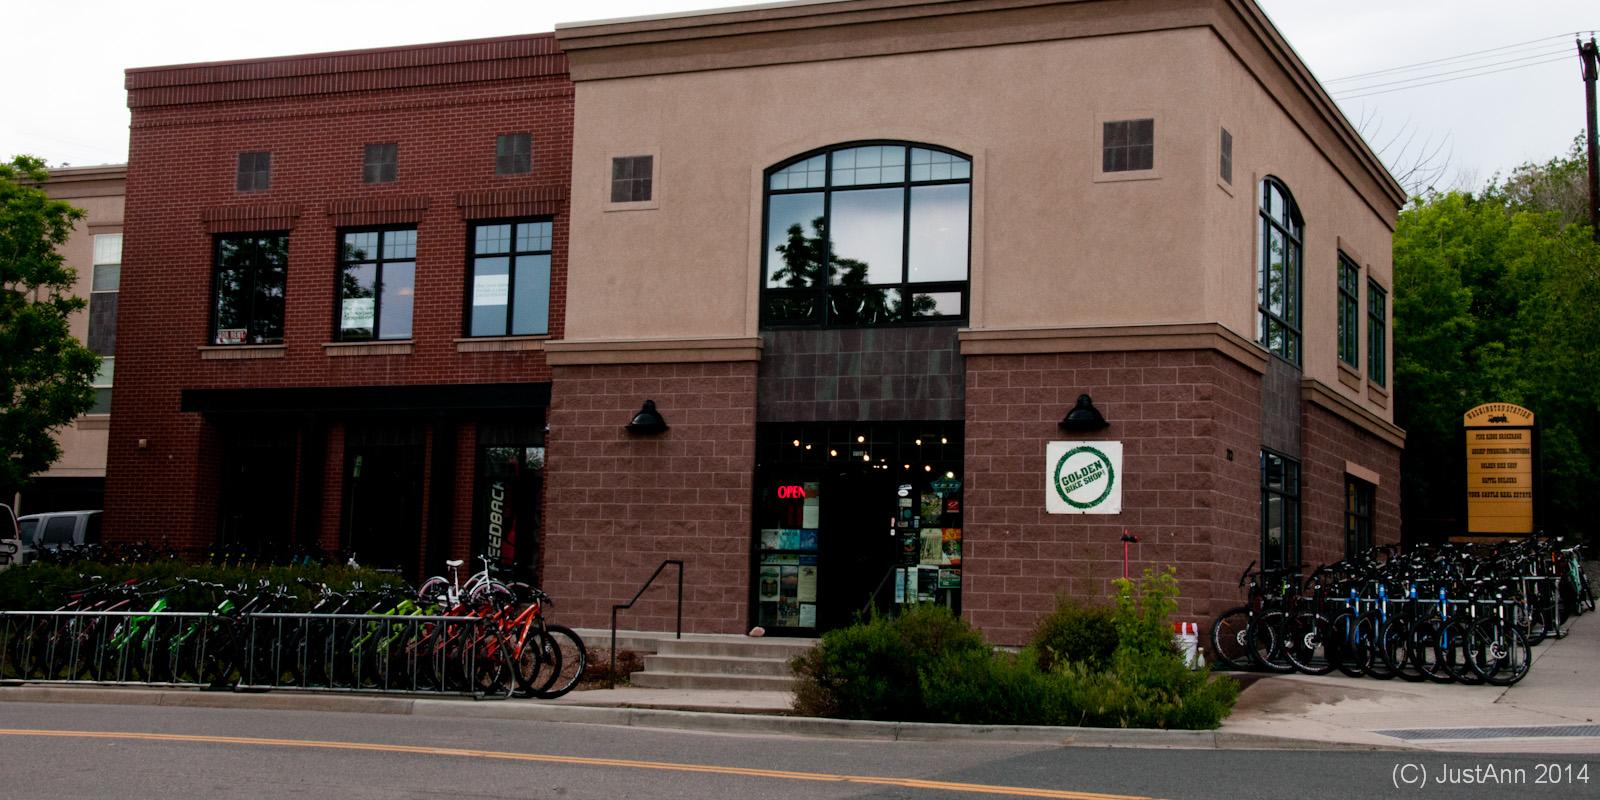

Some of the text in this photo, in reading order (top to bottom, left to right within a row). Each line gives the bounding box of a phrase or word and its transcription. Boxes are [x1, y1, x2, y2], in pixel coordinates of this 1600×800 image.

[1466, 405, 1532, 419] WASHINGTON STATION
[1061, 460, 1103, 486] GOLDEN
[777, 485, 806, 499] OPEN
[1065, 480, 1083, 494] BIKE
